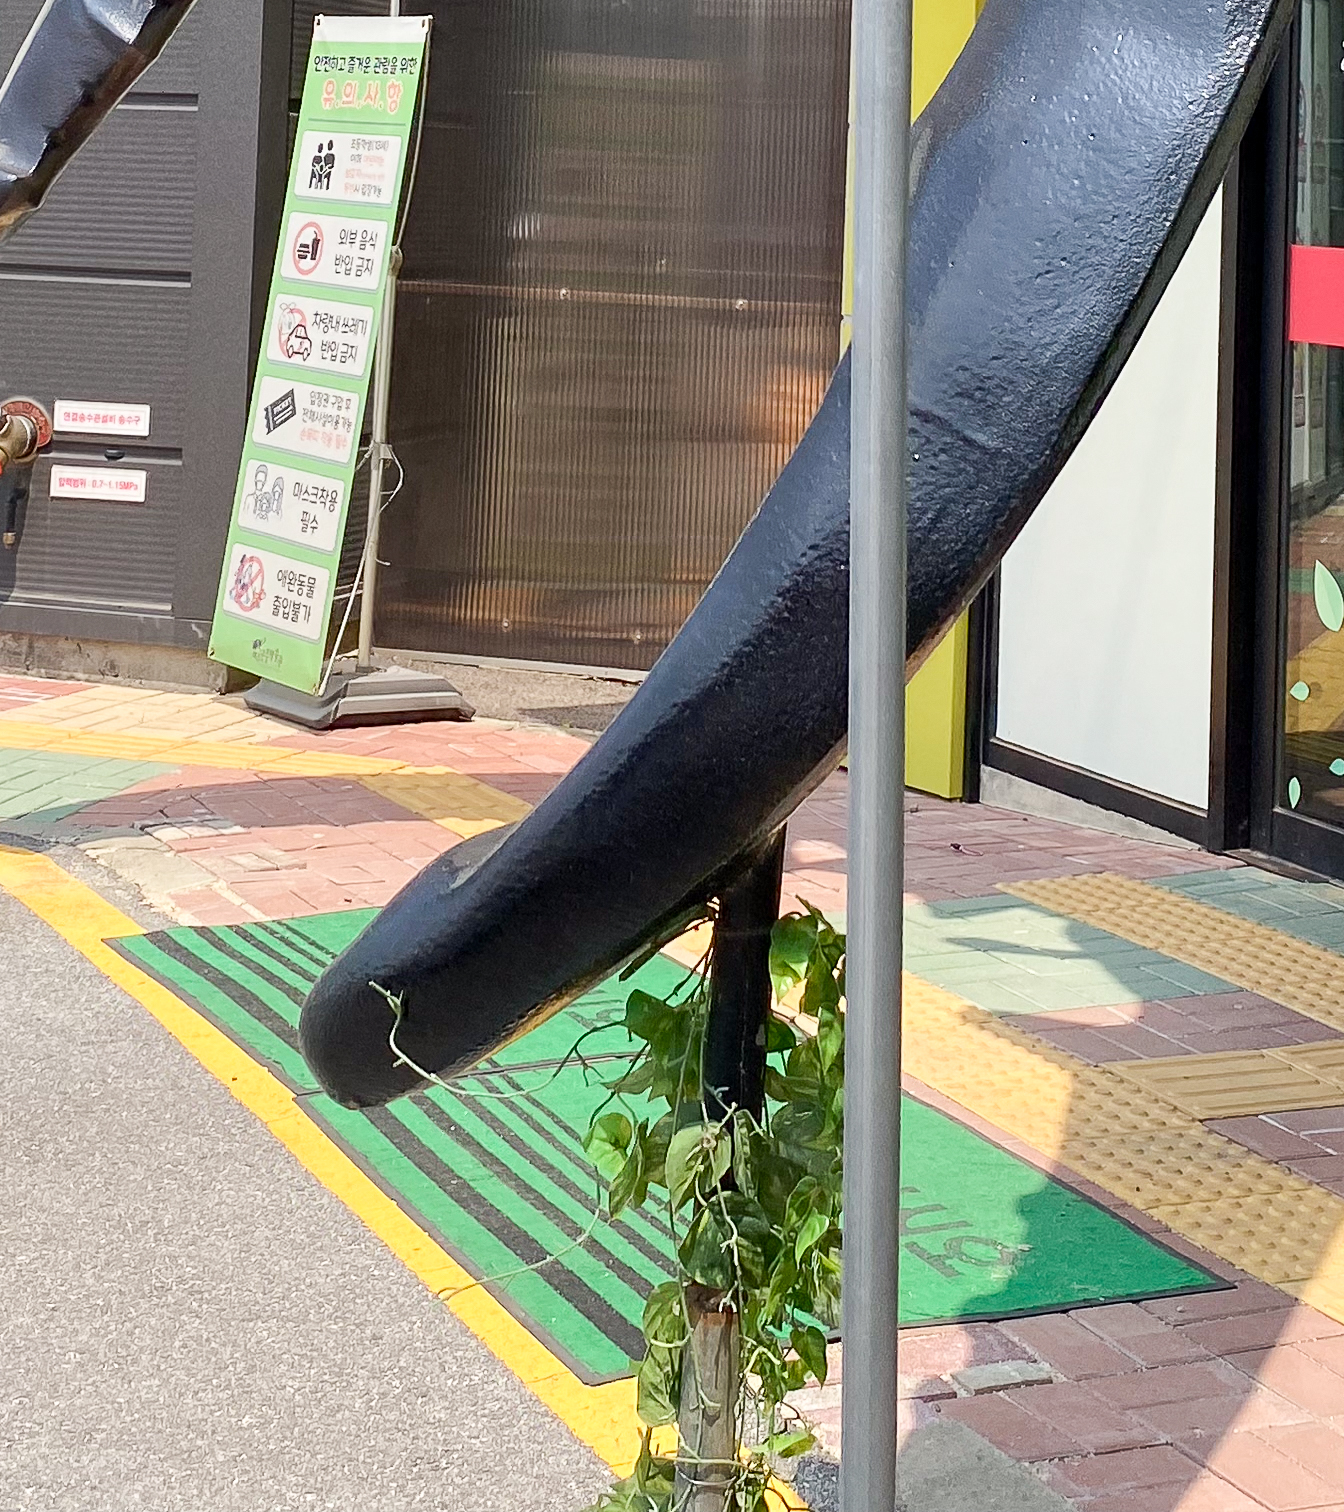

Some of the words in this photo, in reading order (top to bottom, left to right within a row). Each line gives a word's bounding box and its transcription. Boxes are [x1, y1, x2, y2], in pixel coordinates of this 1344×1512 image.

[314, 55, 346, 72] 안전하고
[400, 57, 418, 75] 위한
[338, 228, 358, 248] 외부
[359, 229, 378, 252] 음식
[335, 253, 354, 276] 반입
[355, 256, 374, 277] 금지
[312, 311, 341, 334] 차량내
[341, 317, 368, 337] 쓰레기
[321, 339, 340, 362] 반입
[340, 342, 358, 364] 금지
[293, 481, 338, 512] 마스크착용
[300, 510, 319, 534] 필수
[276, 568, 316, 599] 애완동물
[272, 595, 311, 624] 출입불가
